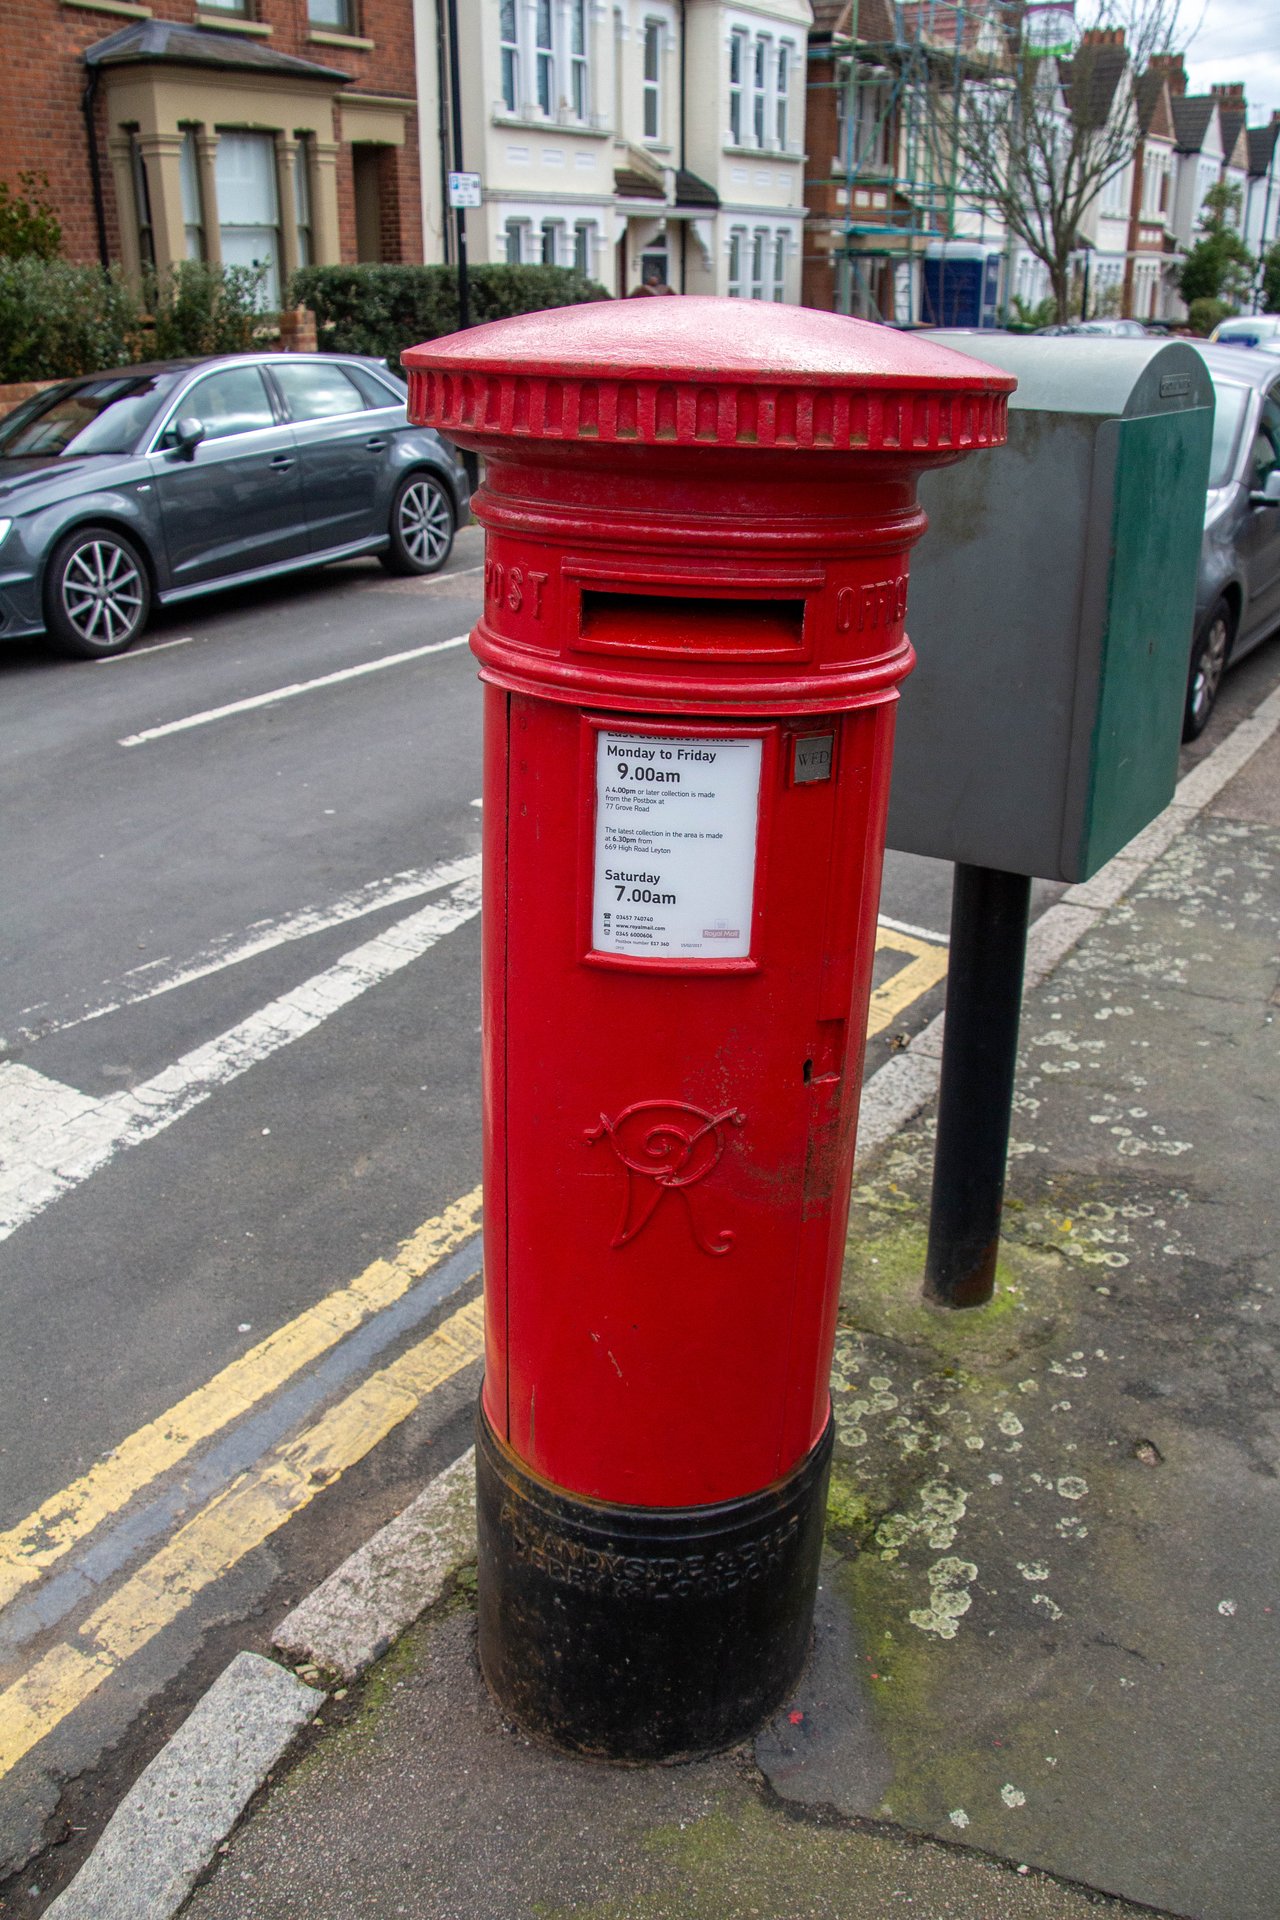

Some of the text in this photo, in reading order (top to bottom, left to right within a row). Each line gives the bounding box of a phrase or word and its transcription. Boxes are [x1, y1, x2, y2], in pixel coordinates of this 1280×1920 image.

[607, 745, 716, 764] Monday to Friday
[618, 762, 680, 782] 9.00am
[612, 787, 636, 795] 4.00pm
[612, 836, 636, 844] 6.30pm
[651, 847, 671, 855] Leyton
[605, 869, 660, 886] Saturday
[614, 885, 676, 904] 7.00am
[616, 924, 666, 932] www.royalmail.com
